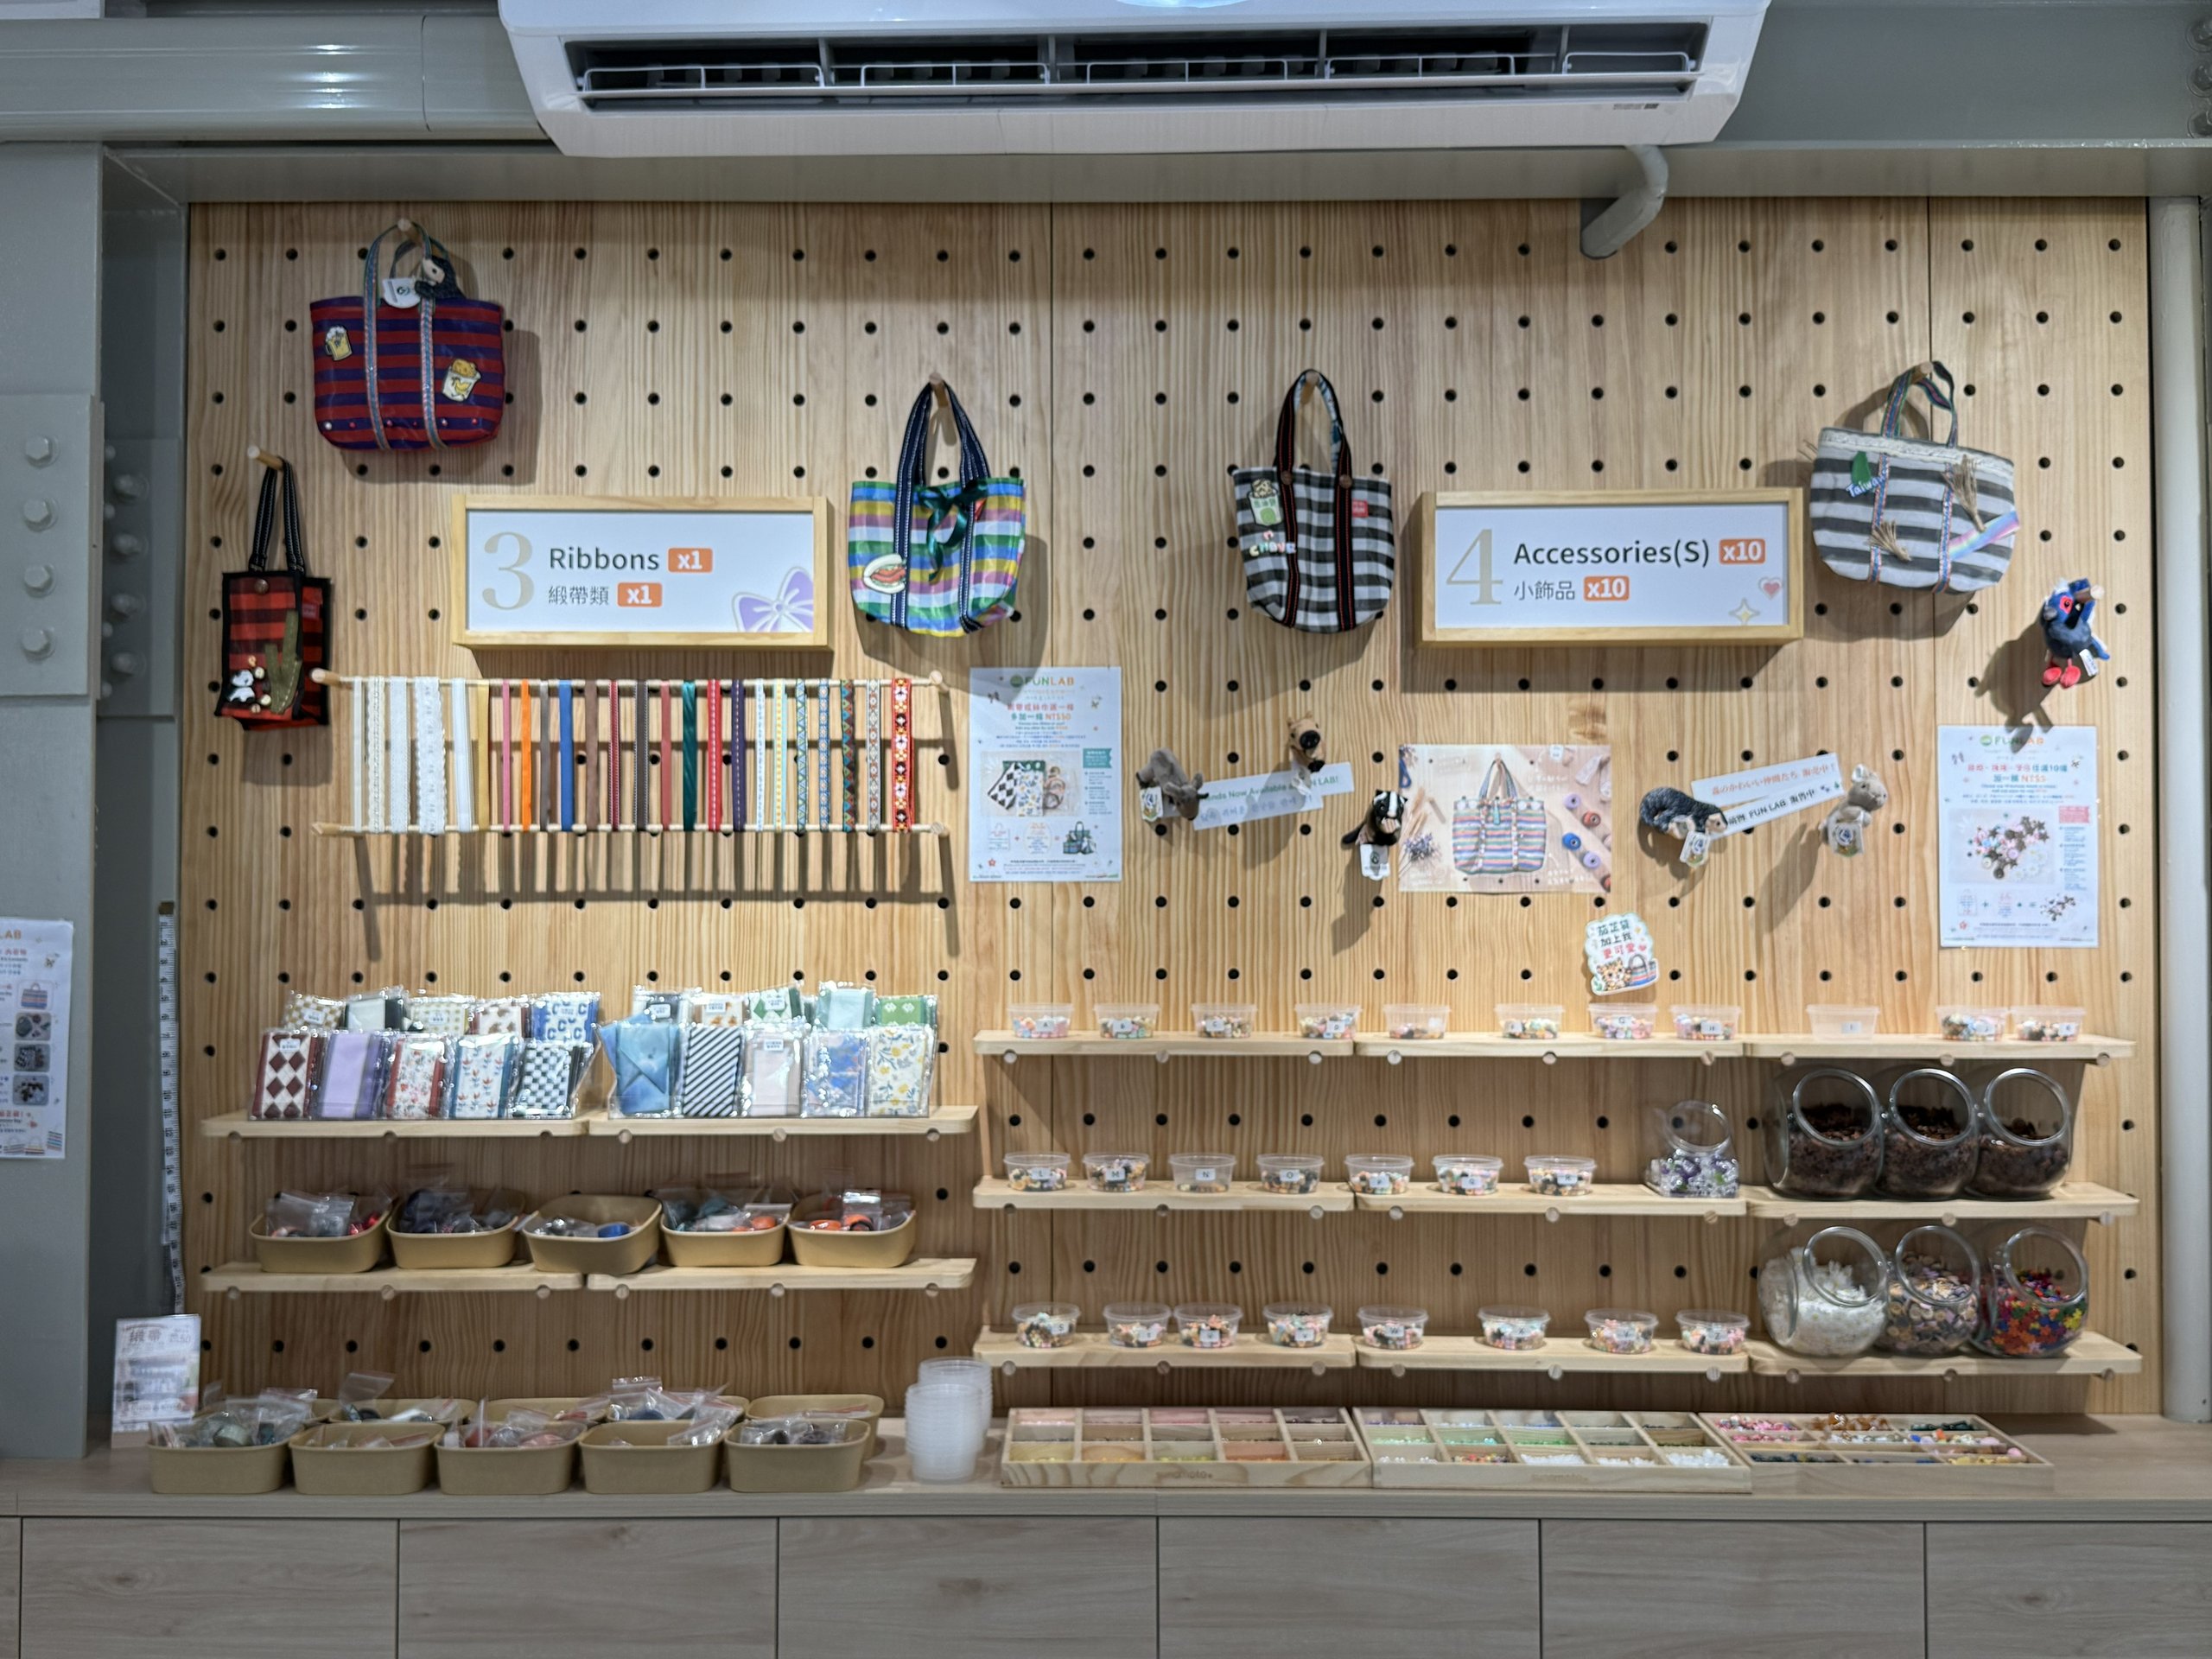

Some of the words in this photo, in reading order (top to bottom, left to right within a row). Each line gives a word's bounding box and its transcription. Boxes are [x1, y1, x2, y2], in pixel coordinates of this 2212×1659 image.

[1845, 474, 1885, 498] Taiwan
[550, 547, 659, 570] Ribbons
[677, 552, 702, 570] x1
[1514, 539, 1710, 569] Accessories(S)
[1722, 541, 1762, 562] x10
[482, 531, 534, 610] 3
[1446, 528, 1503, 605] 4
[549, 585, 610, 606] 緞帶類
[627, 586, 652, 604] x1
[1514, 581, 1576, 601] 小飾品
[1586, 578, 1626, 599] x10
[1228, 790, 1247, 798] Now
[1249, 783, 1287, 796] Available
[1749, 805, 1768, 818] FUN
[1769, 799, 1787, 812] LAB
